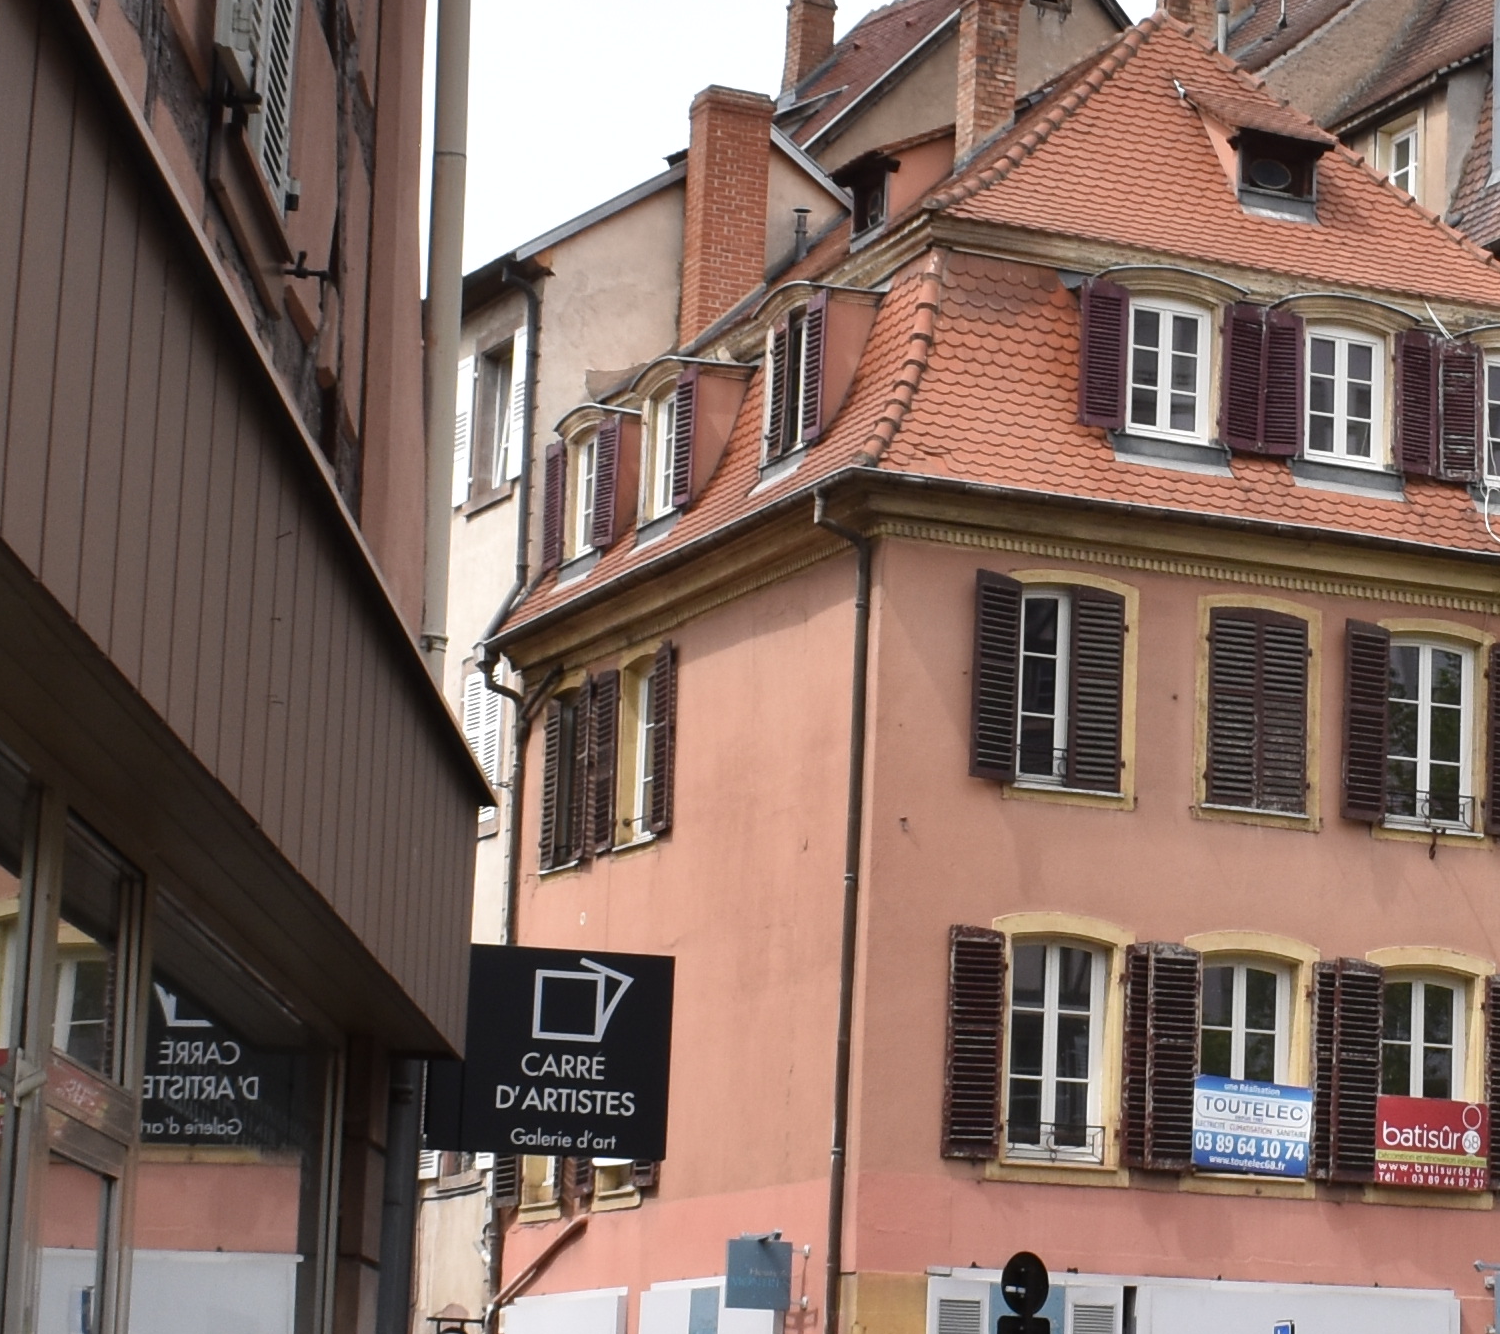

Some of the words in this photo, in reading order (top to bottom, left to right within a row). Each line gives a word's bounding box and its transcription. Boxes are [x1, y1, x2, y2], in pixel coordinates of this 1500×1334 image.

[521, 1052, 605, 1080] CARRÉ
[495, 1085, 635, 1116] D'ARTISTES
[1203, 1095, 1304, 1121] TOUTELEC
[510, 1128, 572, 1148] Galerie
[577, 1131, 617, 1151] d'art
[1195, 1131, 1212, 1151] 03
[1215, 1134, 1234, 1153] 89
[1237, 1137, 1256, 1156] 64
[1260, 1139, 1280, 1159] 10
[1284, 1142, 1304, 1161] 74
[1382, 1120, 1461, 1150] batisûr
[1464, 1135, 1479, 1150] 68
[1209, 1155, 1286, 1171] www.toutelec68.fr
[1378, 1163, 1485, 1177] www.batisur68.fr
[1412, 1174, 1424, 1183] 03
[1428, 1175, 1440, 1185] 89
[1444, 1176, 1455, 1186] 44
[1473, 1178, 1484, 1188] 37
